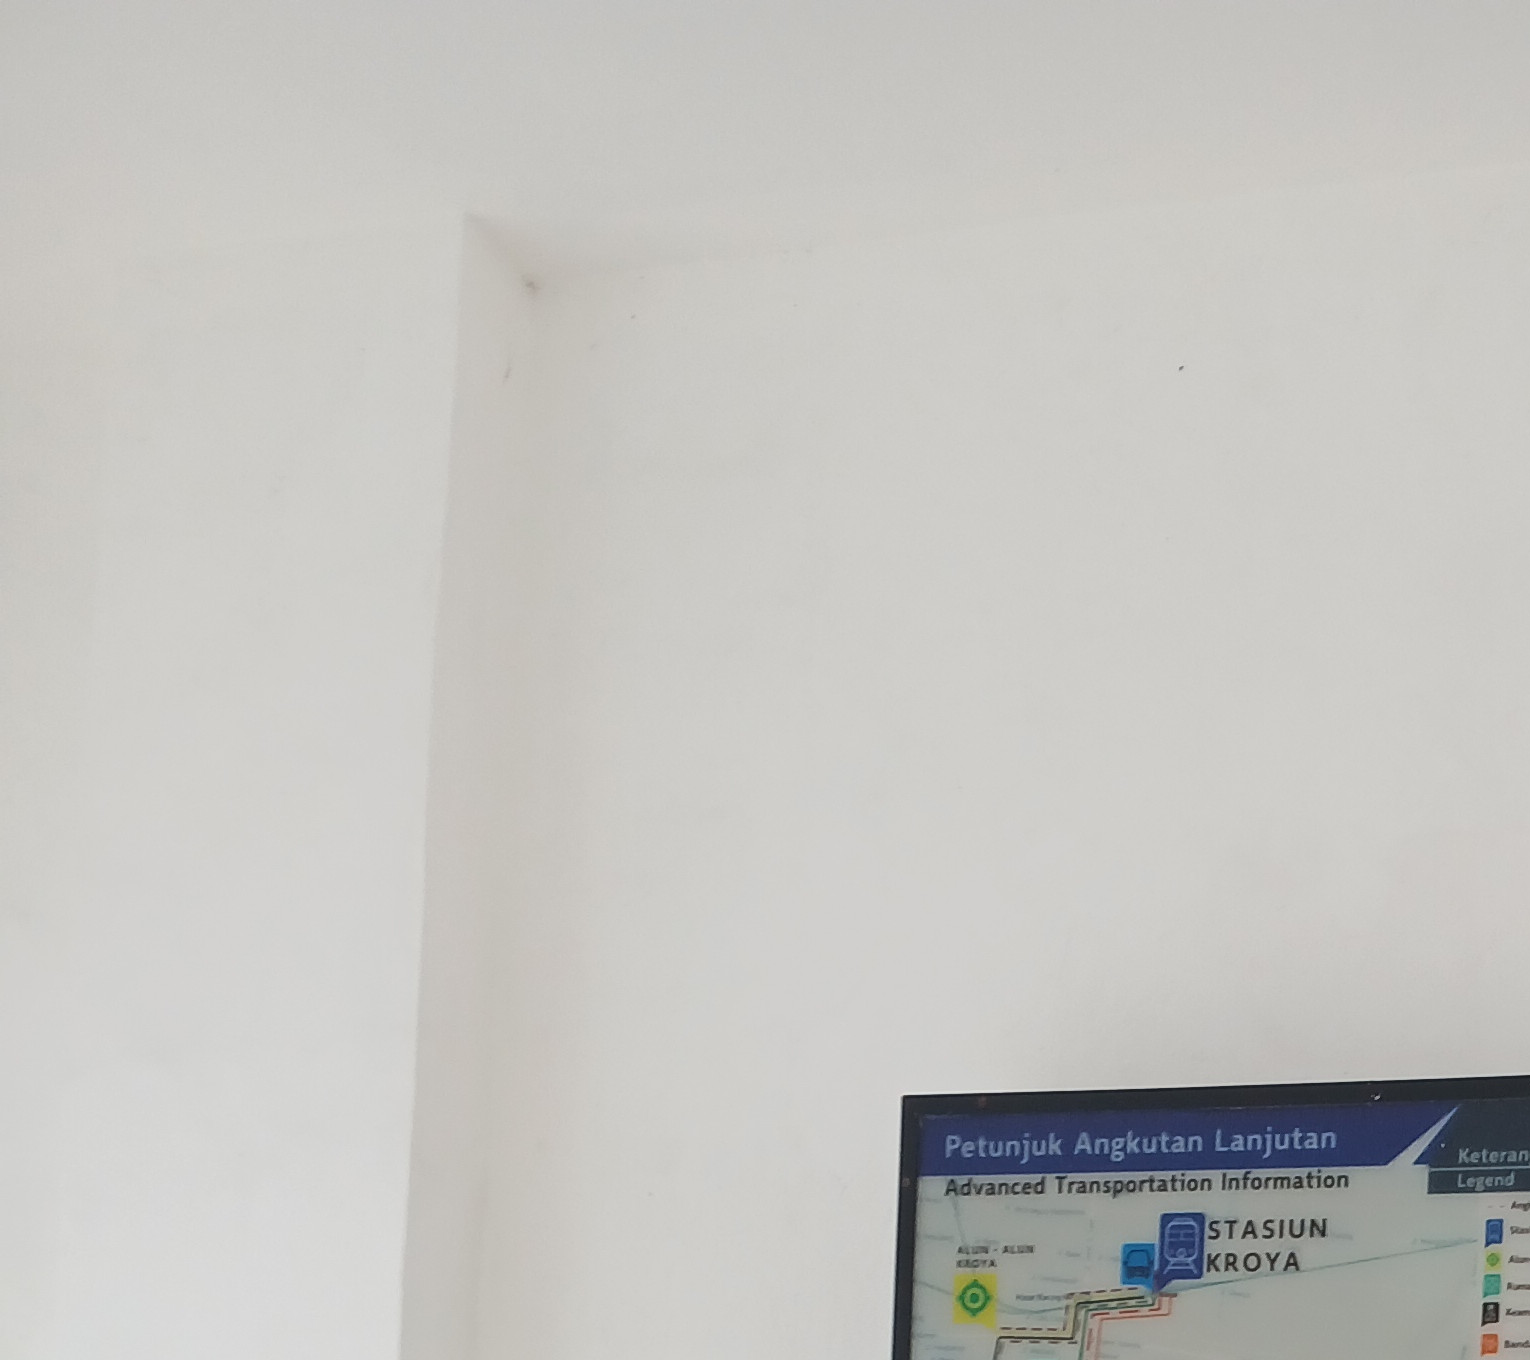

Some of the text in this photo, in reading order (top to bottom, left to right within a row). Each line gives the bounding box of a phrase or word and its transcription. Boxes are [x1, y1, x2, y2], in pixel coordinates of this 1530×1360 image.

[944, 1127, 1337, 1164] Petunjuk Angkutan Lanjutan
[944, 1171, 1350, 1199] Advanced Transportation Information
[1457, 1172, 1515, 1191] Legend
[1207, 1217, 1328, 1240] STASIUN
[1207, 1252, 1301, 1273] KROYA
